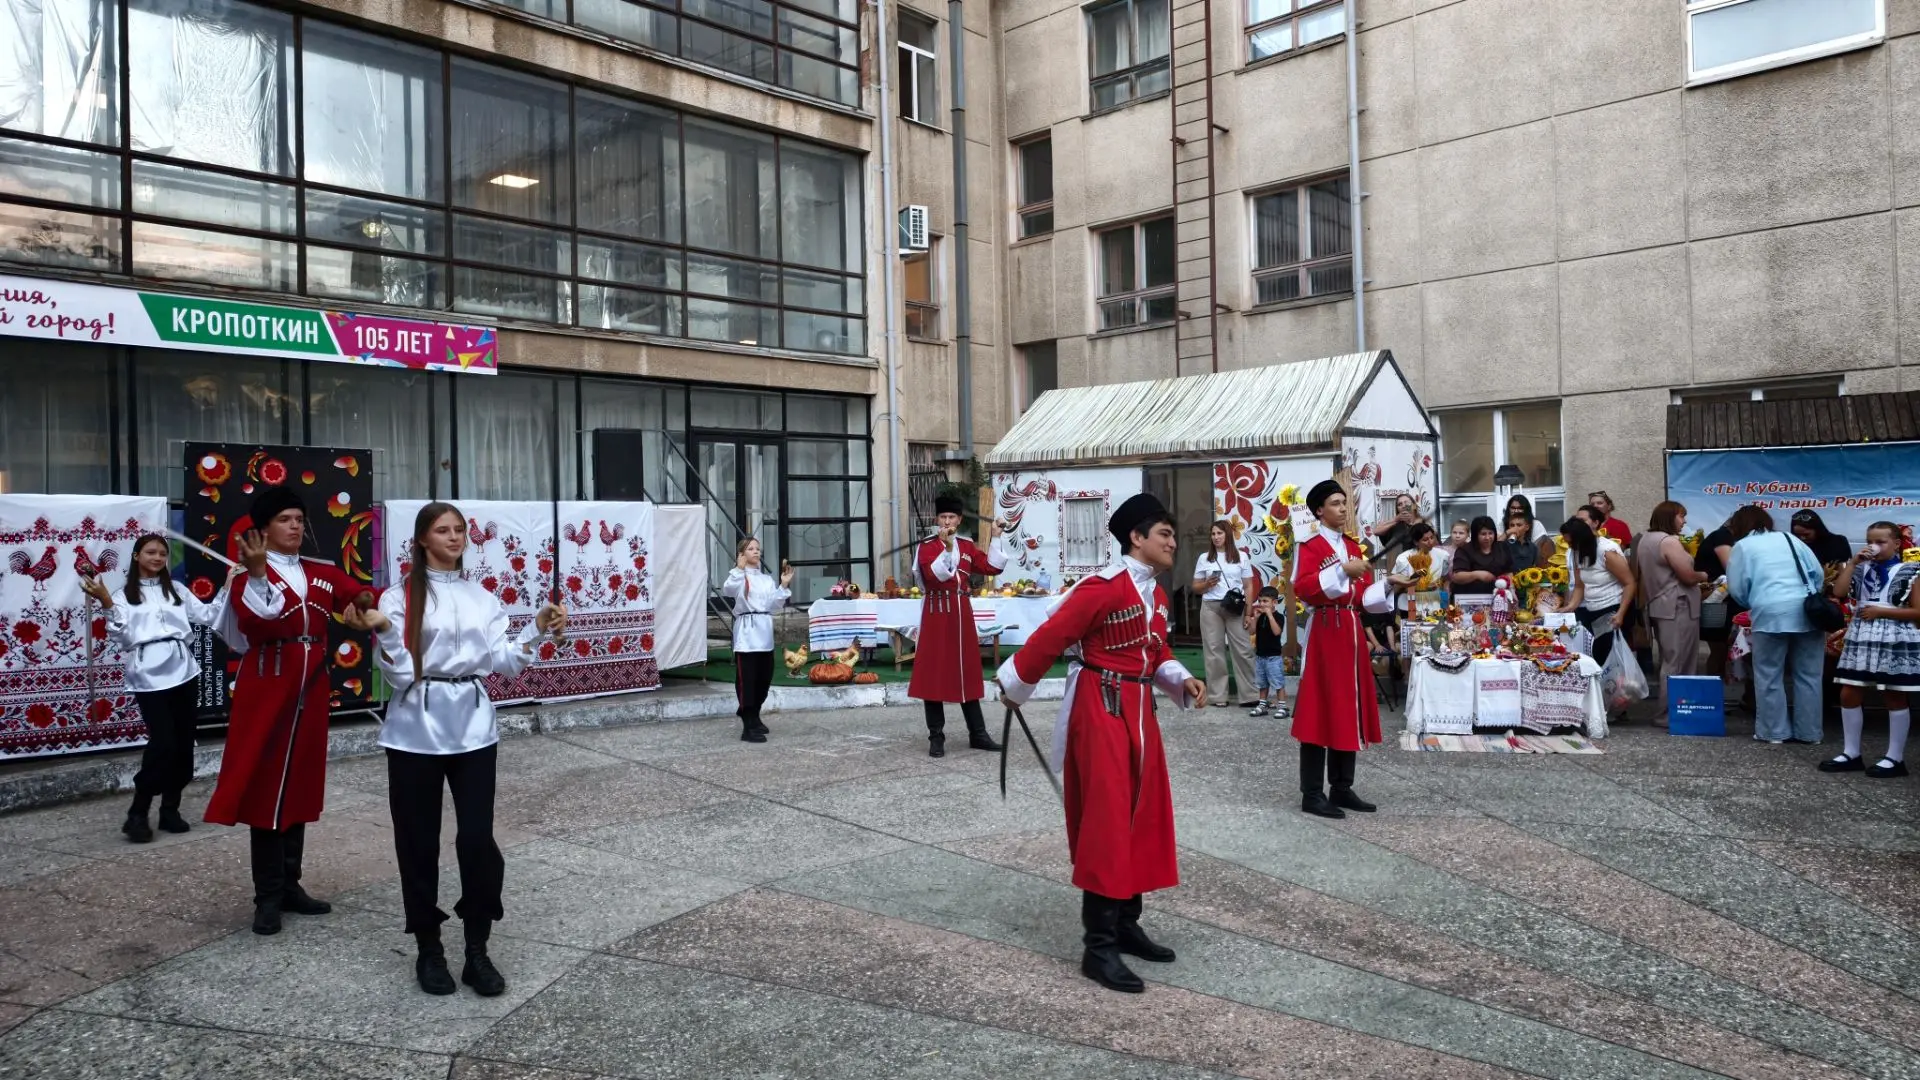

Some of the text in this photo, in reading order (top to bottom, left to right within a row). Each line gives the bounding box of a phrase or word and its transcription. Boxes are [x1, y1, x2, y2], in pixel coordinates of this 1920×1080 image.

[26, 313, 115, 340] город!
[172, 307, 319, 345] КРОПОТКИН
[354, 326, 433, 355] 105 ЛЕТ
[1703, 481, 1811, 496] «Ты Кубань
[1779, 497, 1828, 509] наша
[204, 666, 213, 707] КУЛЬТУРЫ
